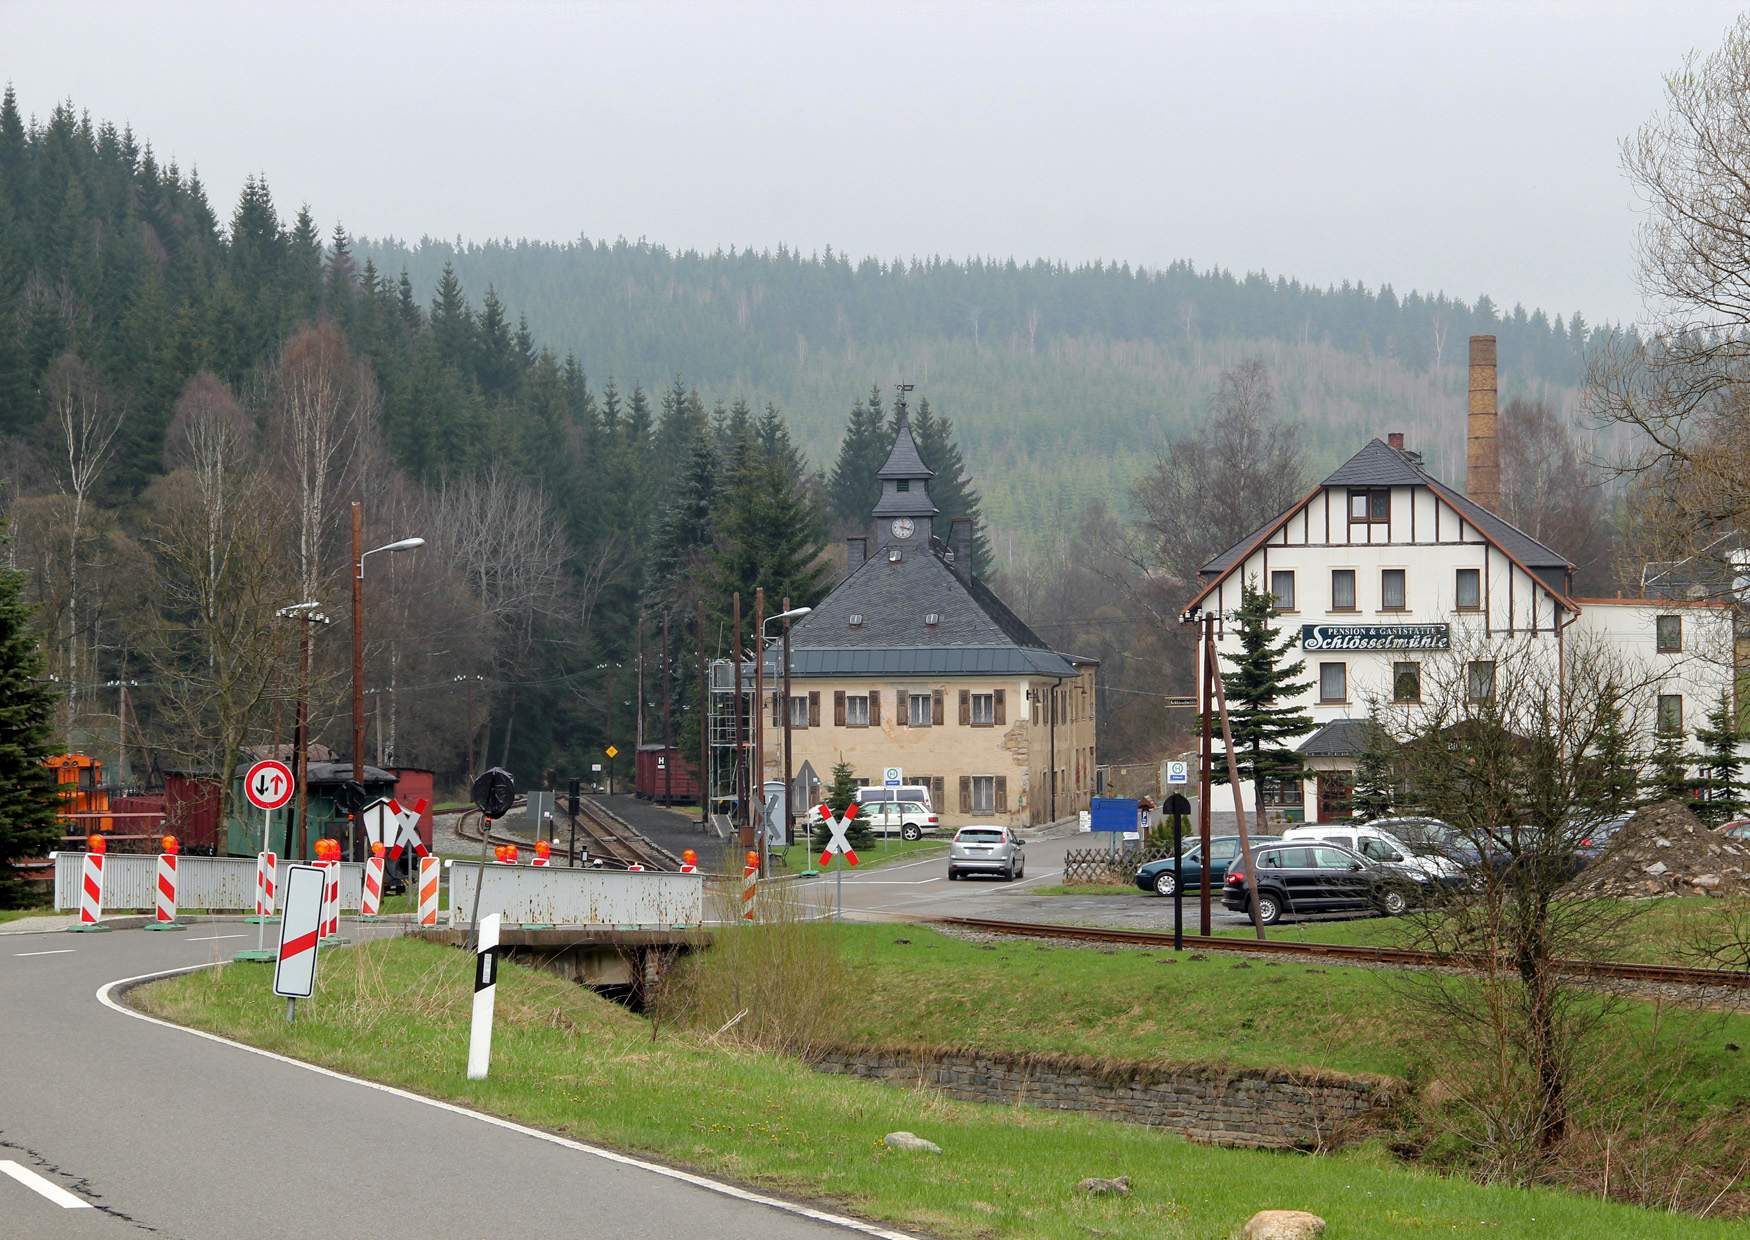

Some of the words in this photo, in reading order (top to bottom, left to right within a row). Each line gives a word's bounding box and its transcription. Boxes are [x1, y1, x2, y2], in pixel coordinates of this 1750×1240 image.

[1328, 627, 1366, 636] PENSION
[1369, 627, 1376, 636] &
[1304, 625, 1448, 650] Schlösselmühle
[658, 756, 665, 765] H
